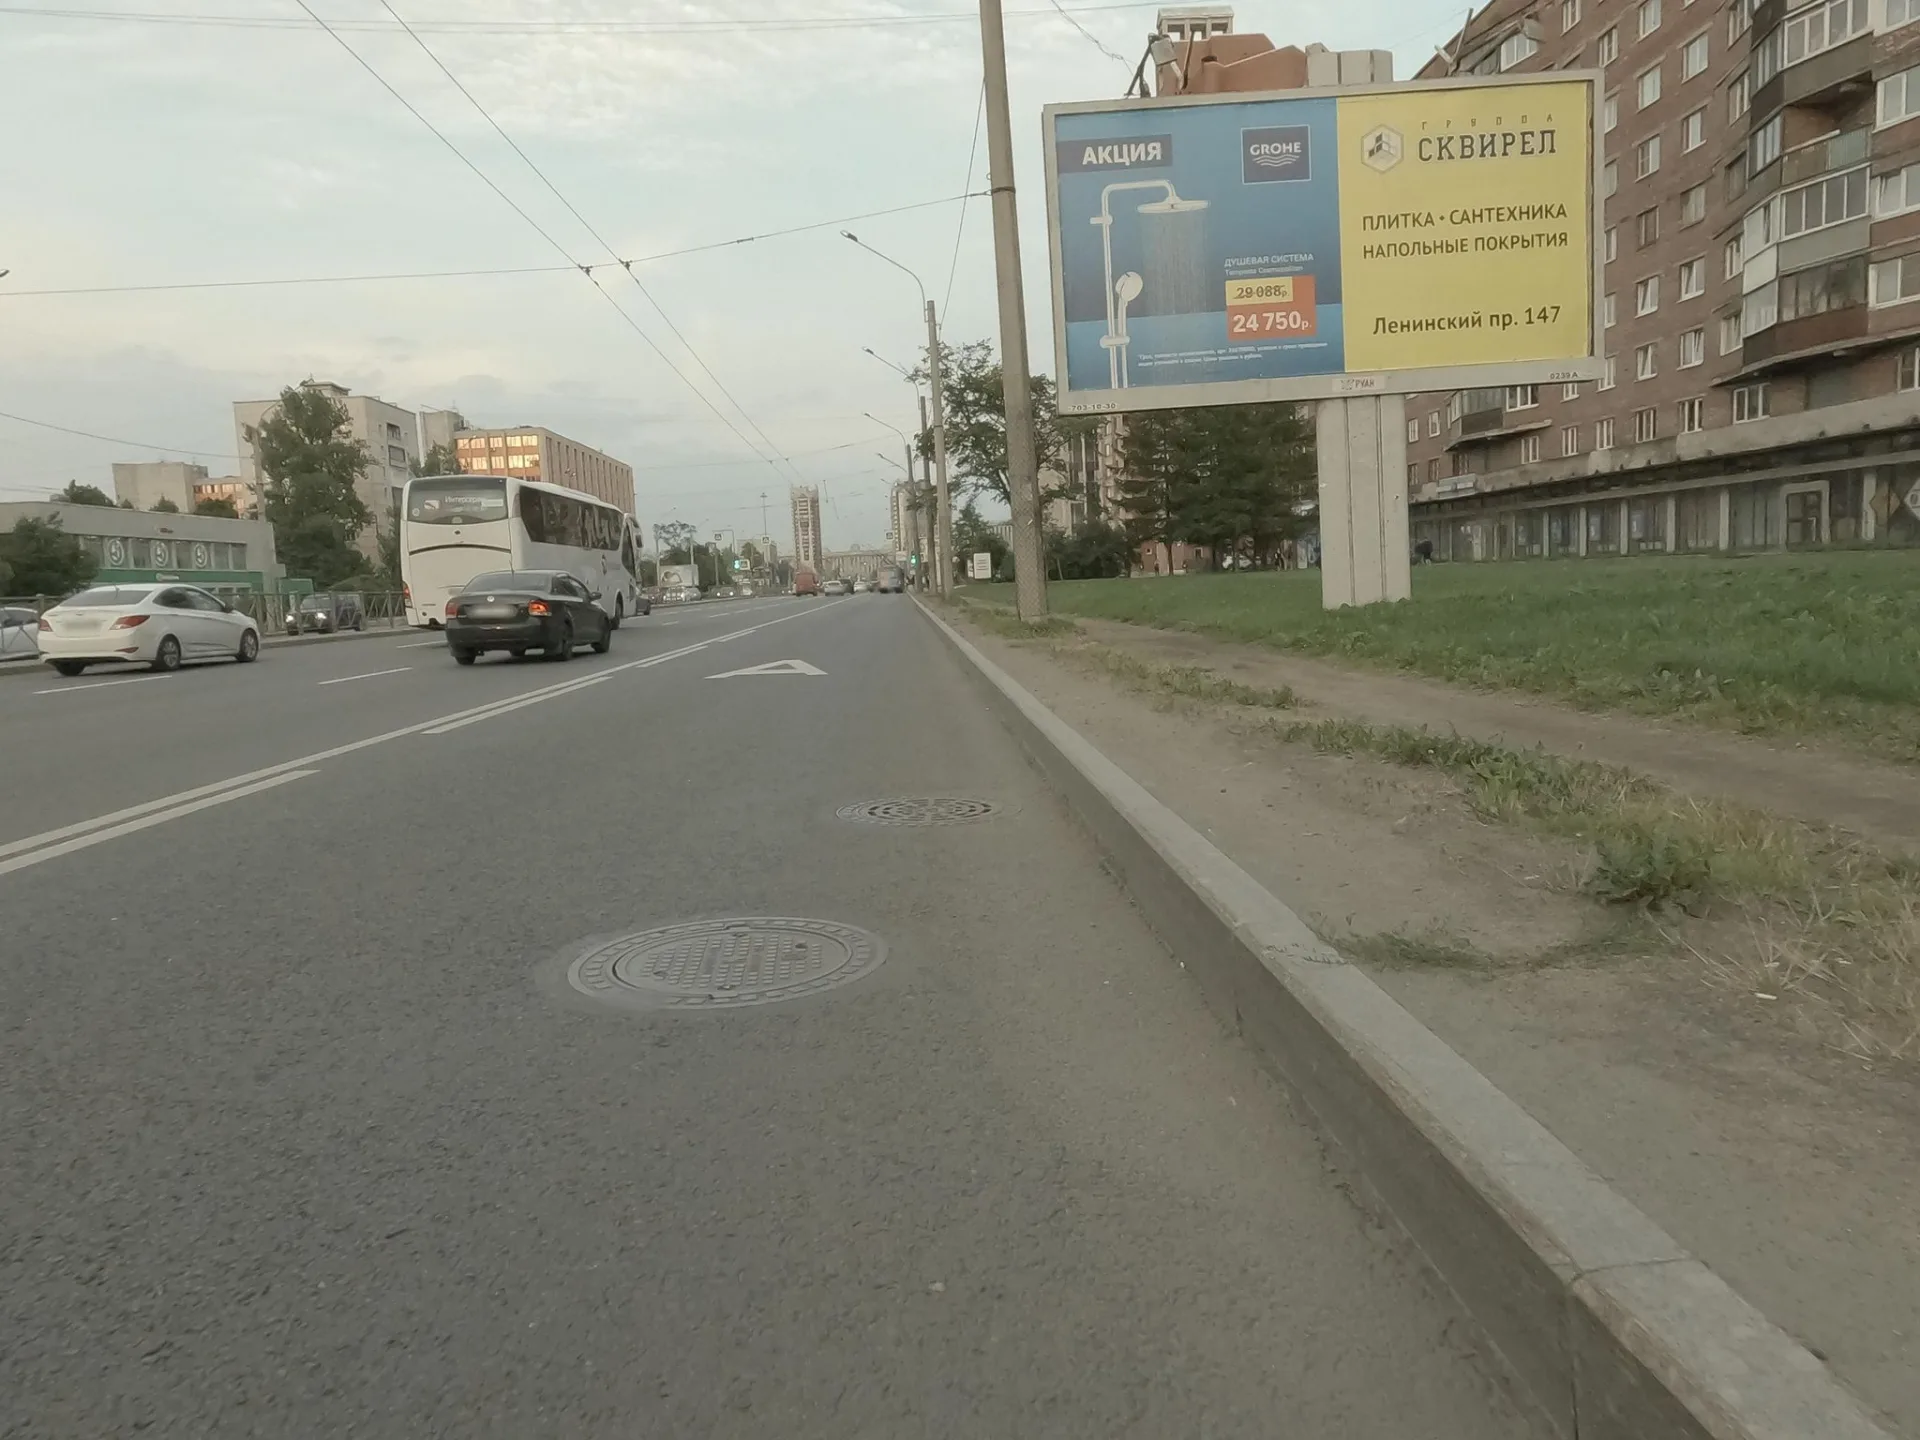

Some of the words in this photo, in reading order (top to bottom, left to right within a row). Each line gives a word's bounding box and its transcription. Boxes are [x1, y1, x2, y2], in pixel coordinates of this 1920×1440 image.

[1082, 142, 1163, 166] АКЦИЯ
[1250, 142, 1302, 156] GROHE
[1418, 129, 1556, 162] СКВИРЕЛ
[1362, 211, 1435, 231] ПЛИТКА
[1449, 203, 1568, 225] САНТЕХНИКА
[1362, 237, 1469, 259] НАПОЛЬНЫЕ
[1474, 231, 1568, 251] ПОКРЫТИЯ
[1224, 255, 1269, 268] ДУШЕВАЯ
[1270, 253, 1314, 264] СИСТЕМА
[1232, 313, 1259, 333] 24
[1373, 311, 1482, 335] Ленинский
[1490, 312, 1519, 331] пр.
[1525, 306, 1561, 325] 147
